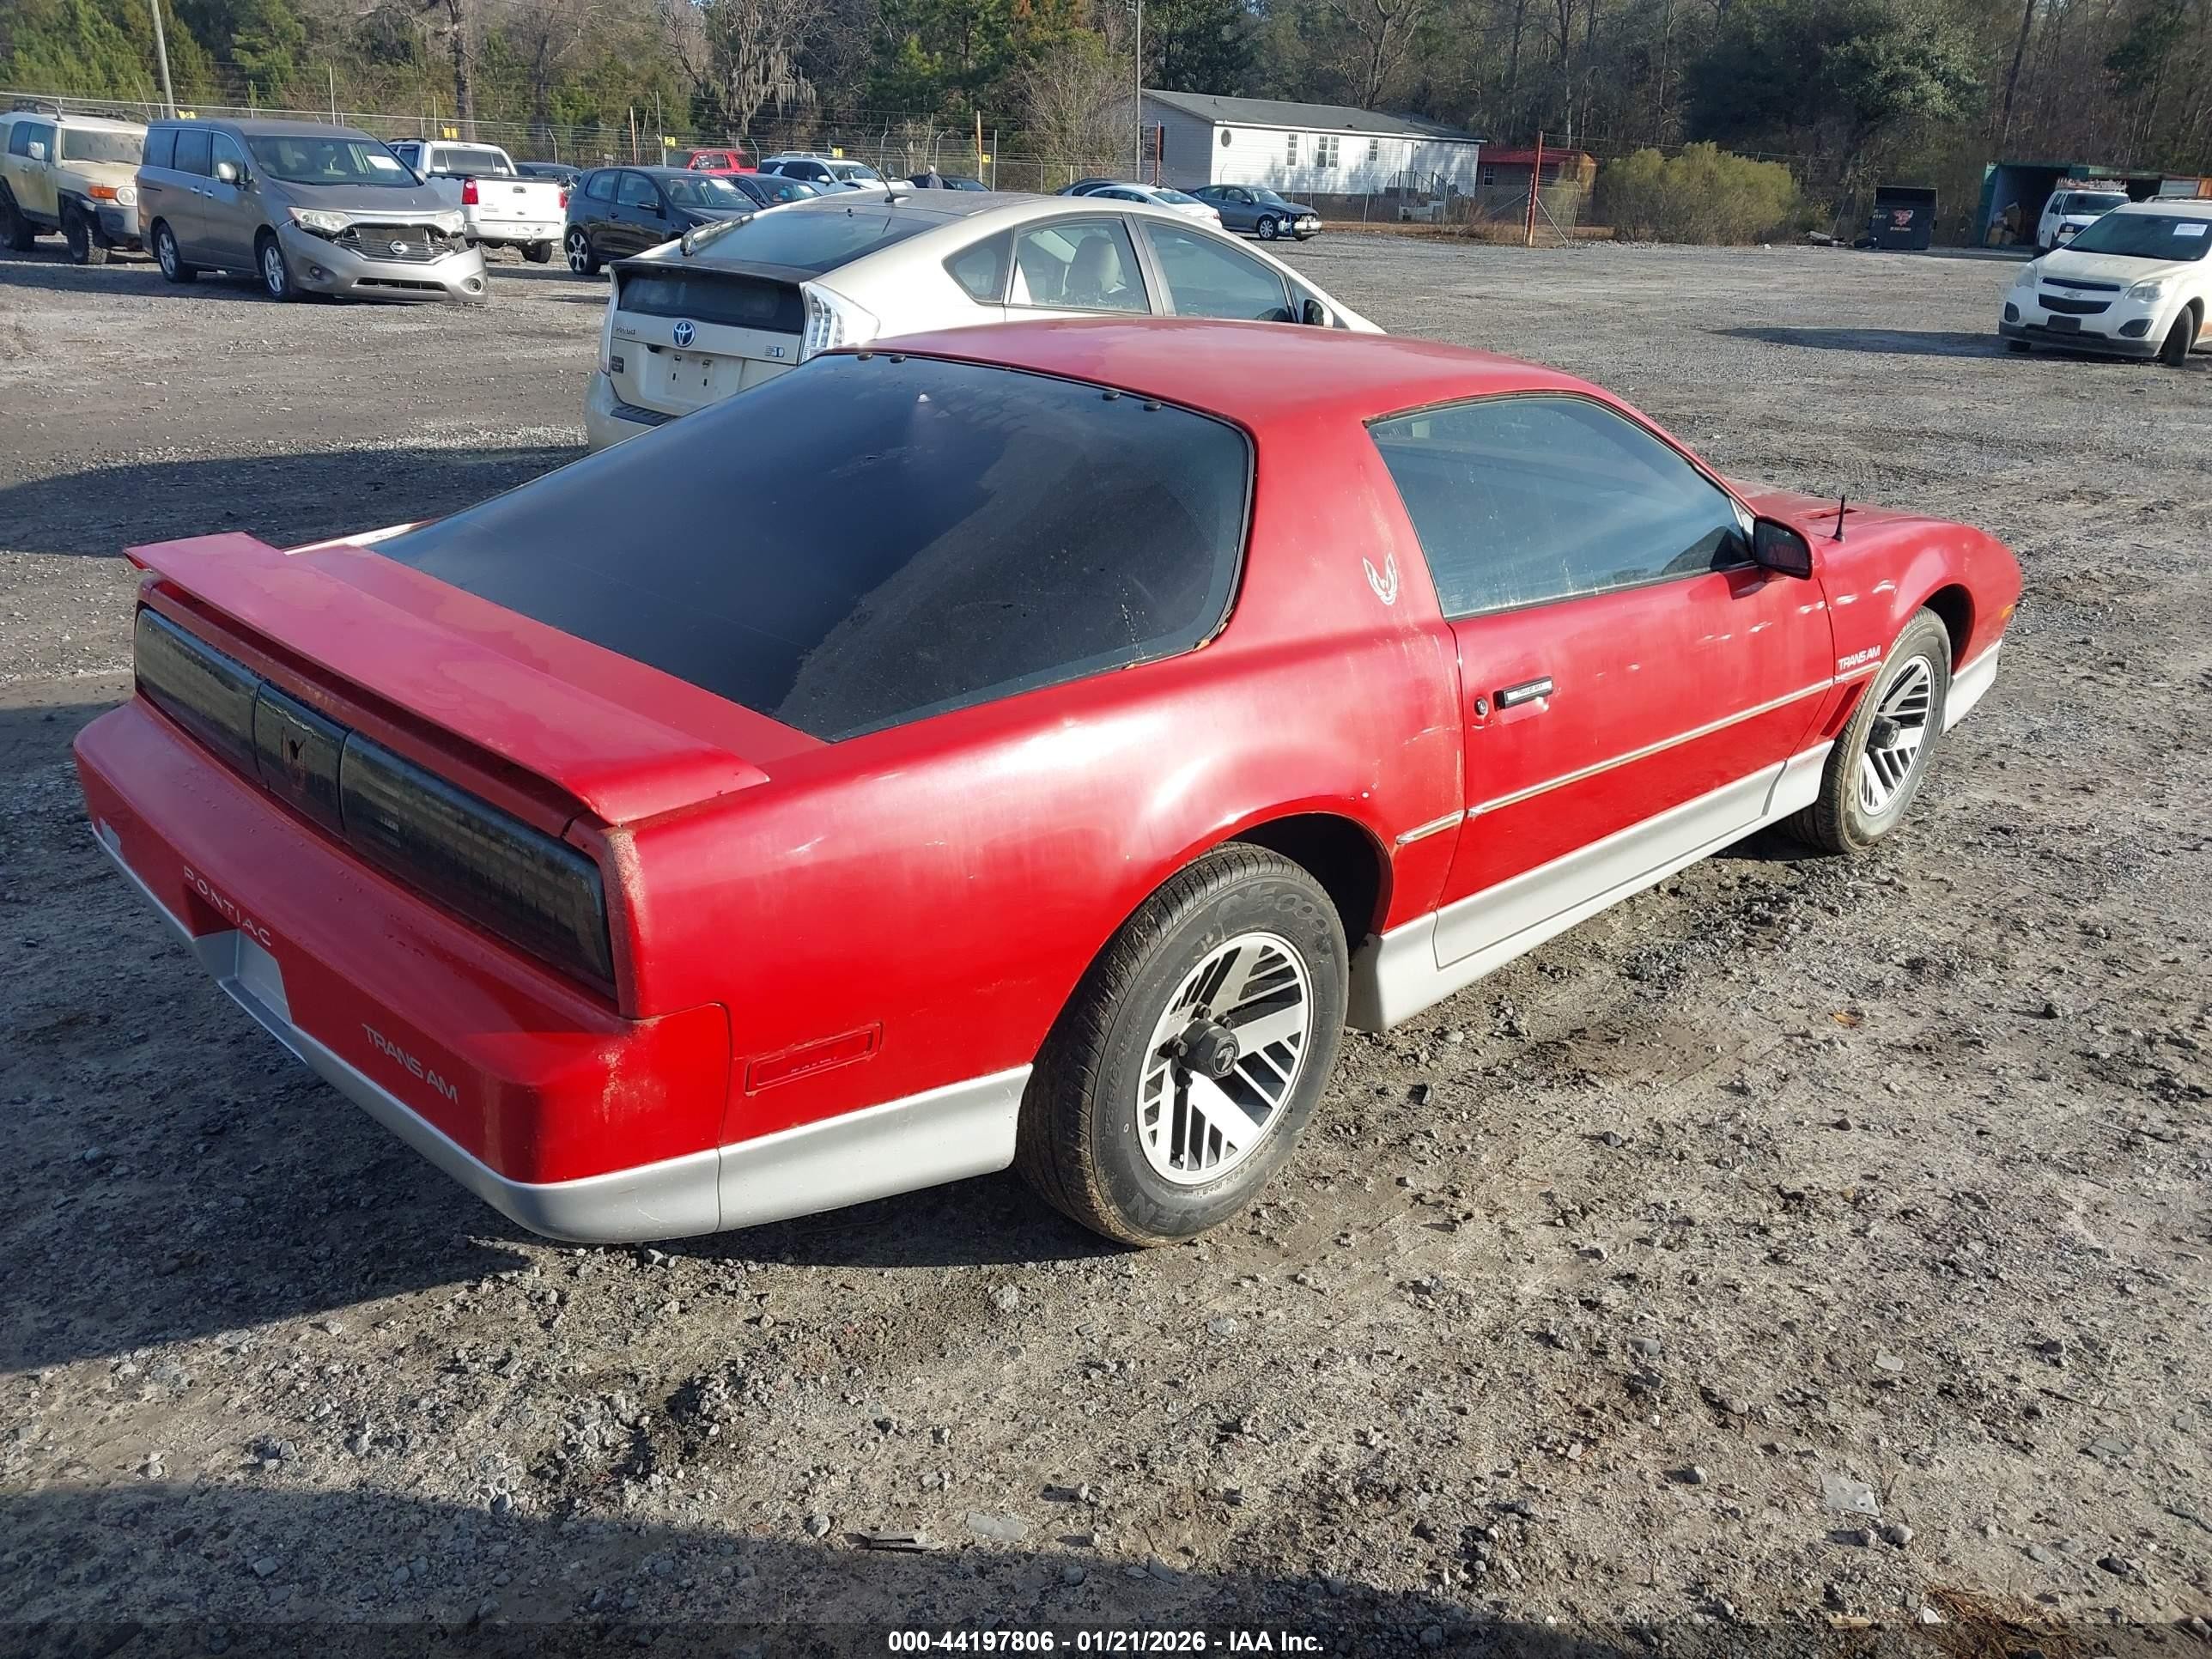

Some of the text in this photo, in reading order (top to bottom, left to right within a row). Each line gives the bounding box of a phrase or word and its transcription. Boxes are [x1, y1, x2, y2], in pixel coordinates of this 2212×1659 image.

[1838, 644, 1881, 671] TRANS AM
[183, 865, 271, 946] PONTIAC
[361, 1023, 459, 1106] TRANS AM
